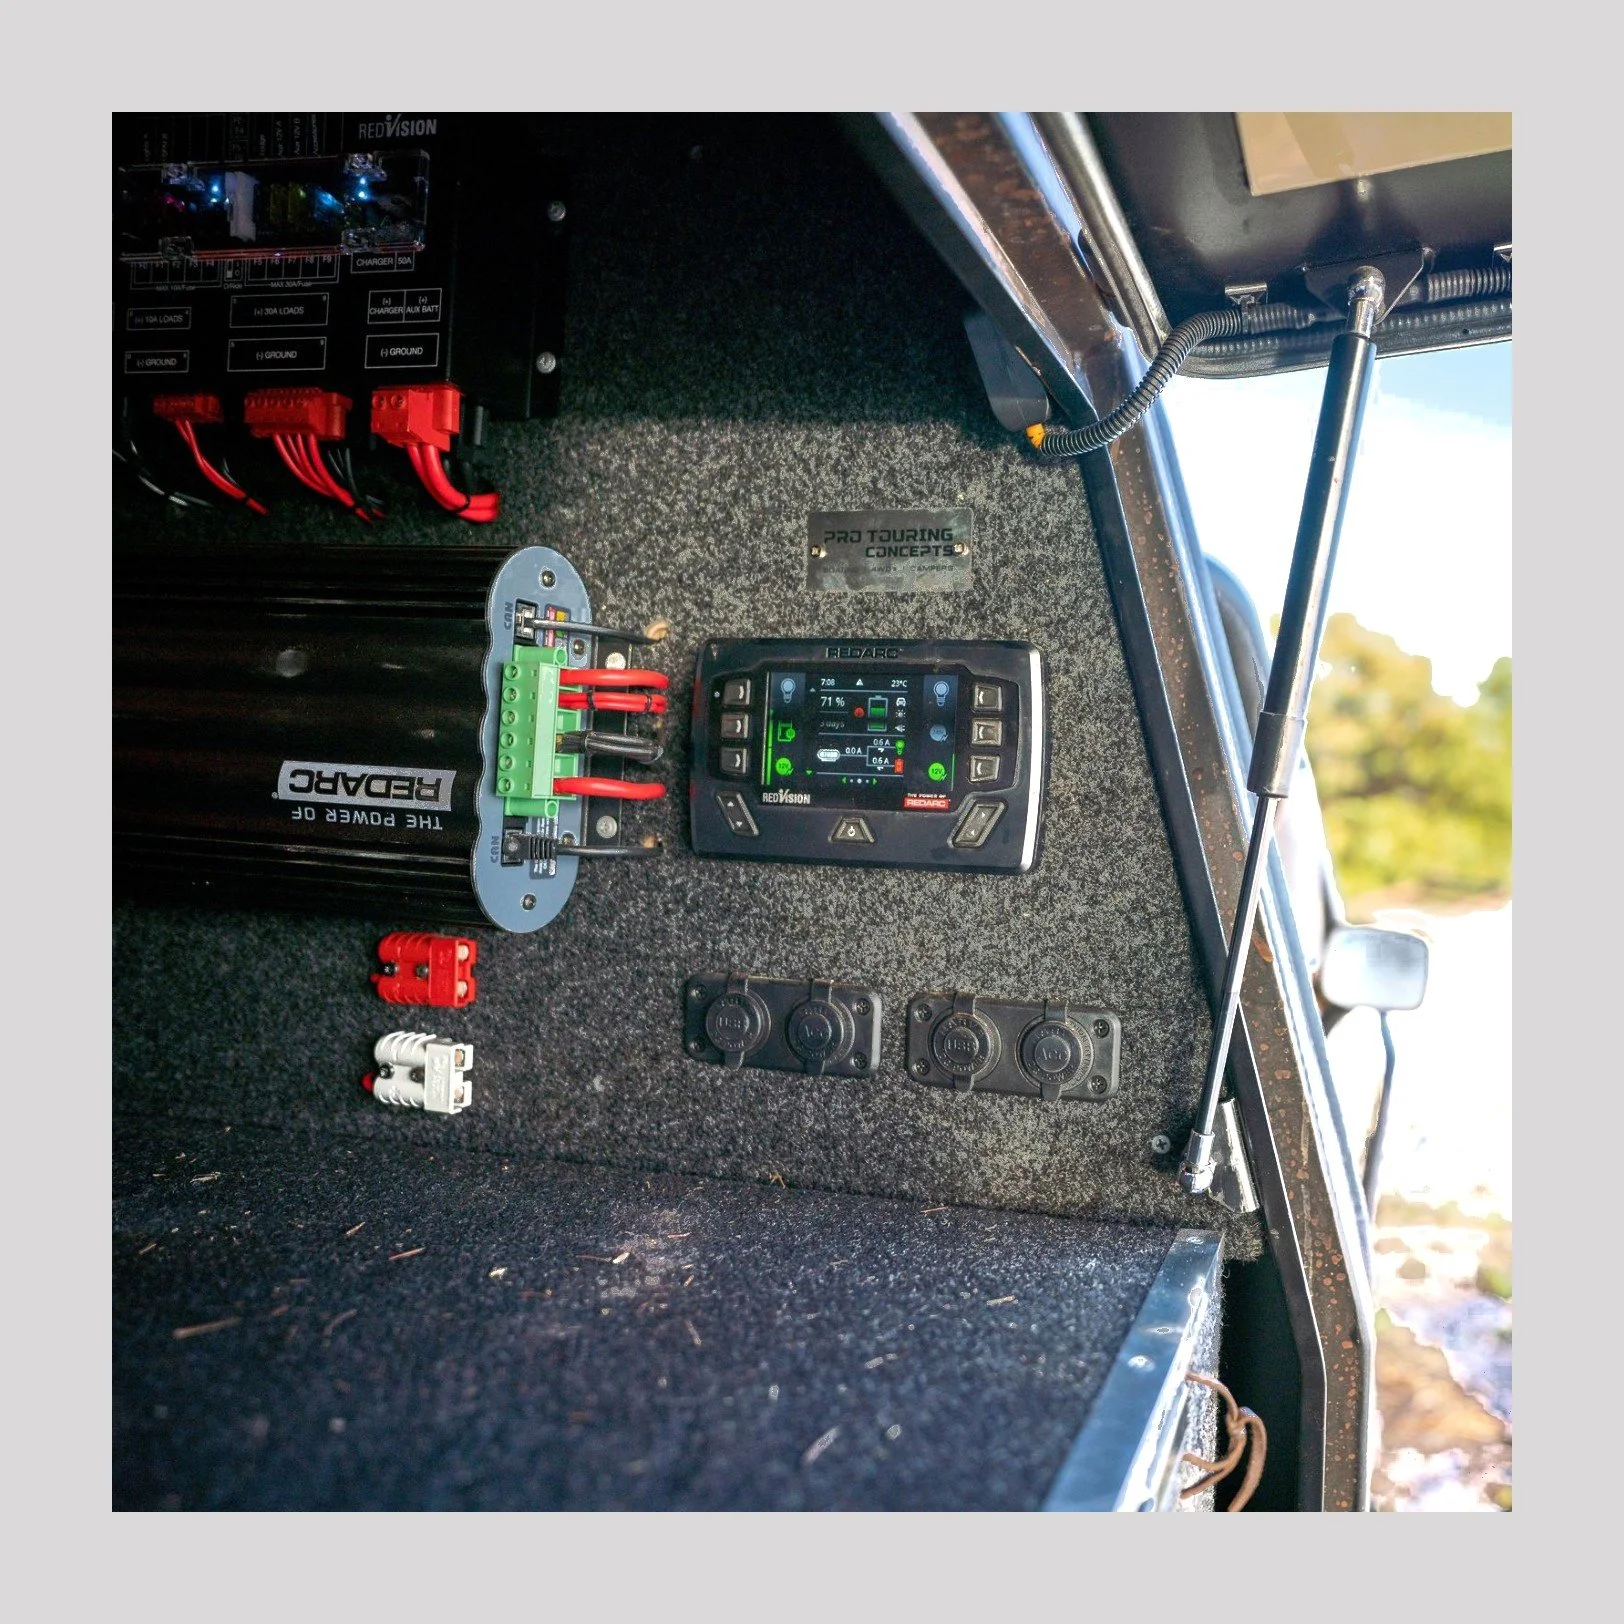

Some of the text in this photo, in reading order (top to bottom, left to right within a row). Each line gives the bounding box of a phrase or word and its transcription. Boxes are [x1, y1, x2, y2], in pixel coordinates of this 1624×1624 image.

[323, 255, 332, 263] F9
[356, 258, 393, 267] CHARGER
[397, 257, 412, 265] 50A
[382, 297, 392, 306] (+)
[418, 296, 428, 305] (+)
[254, 306, 304, 317] (+) 30A LOADS
[369, 306, 404, 315] CHARGER
[406, 305, 439, 314] AUX BATT
[159, 315, 184, 323] LOADS
[265, 350, 297, 359] GROUND
[380, 347, 423, 358] (-) GROUND
[144, 358, 177, 367] GROUND
[824, 528, 953, 544] PRO TOURING
[865, 544, 954, 558] CONCEPTS
[504, 602, 513, 630] CAN
[825, 647, 898, 659] REDARC
[820, 679, 836, 687] 7:08
[891, 679, 908, 688] 23°C
[820, 696, 845, 707] 71 %
[872, 757, 883, 765] 0.6
[779, 762, 789, 770] 12V
[288, 769, 442, 802] REDARC
[907, 799, 946, 807] REDARC
[291, 806, 443, 830] THE POWER OF
[490, 835, 500, 863] CAN
